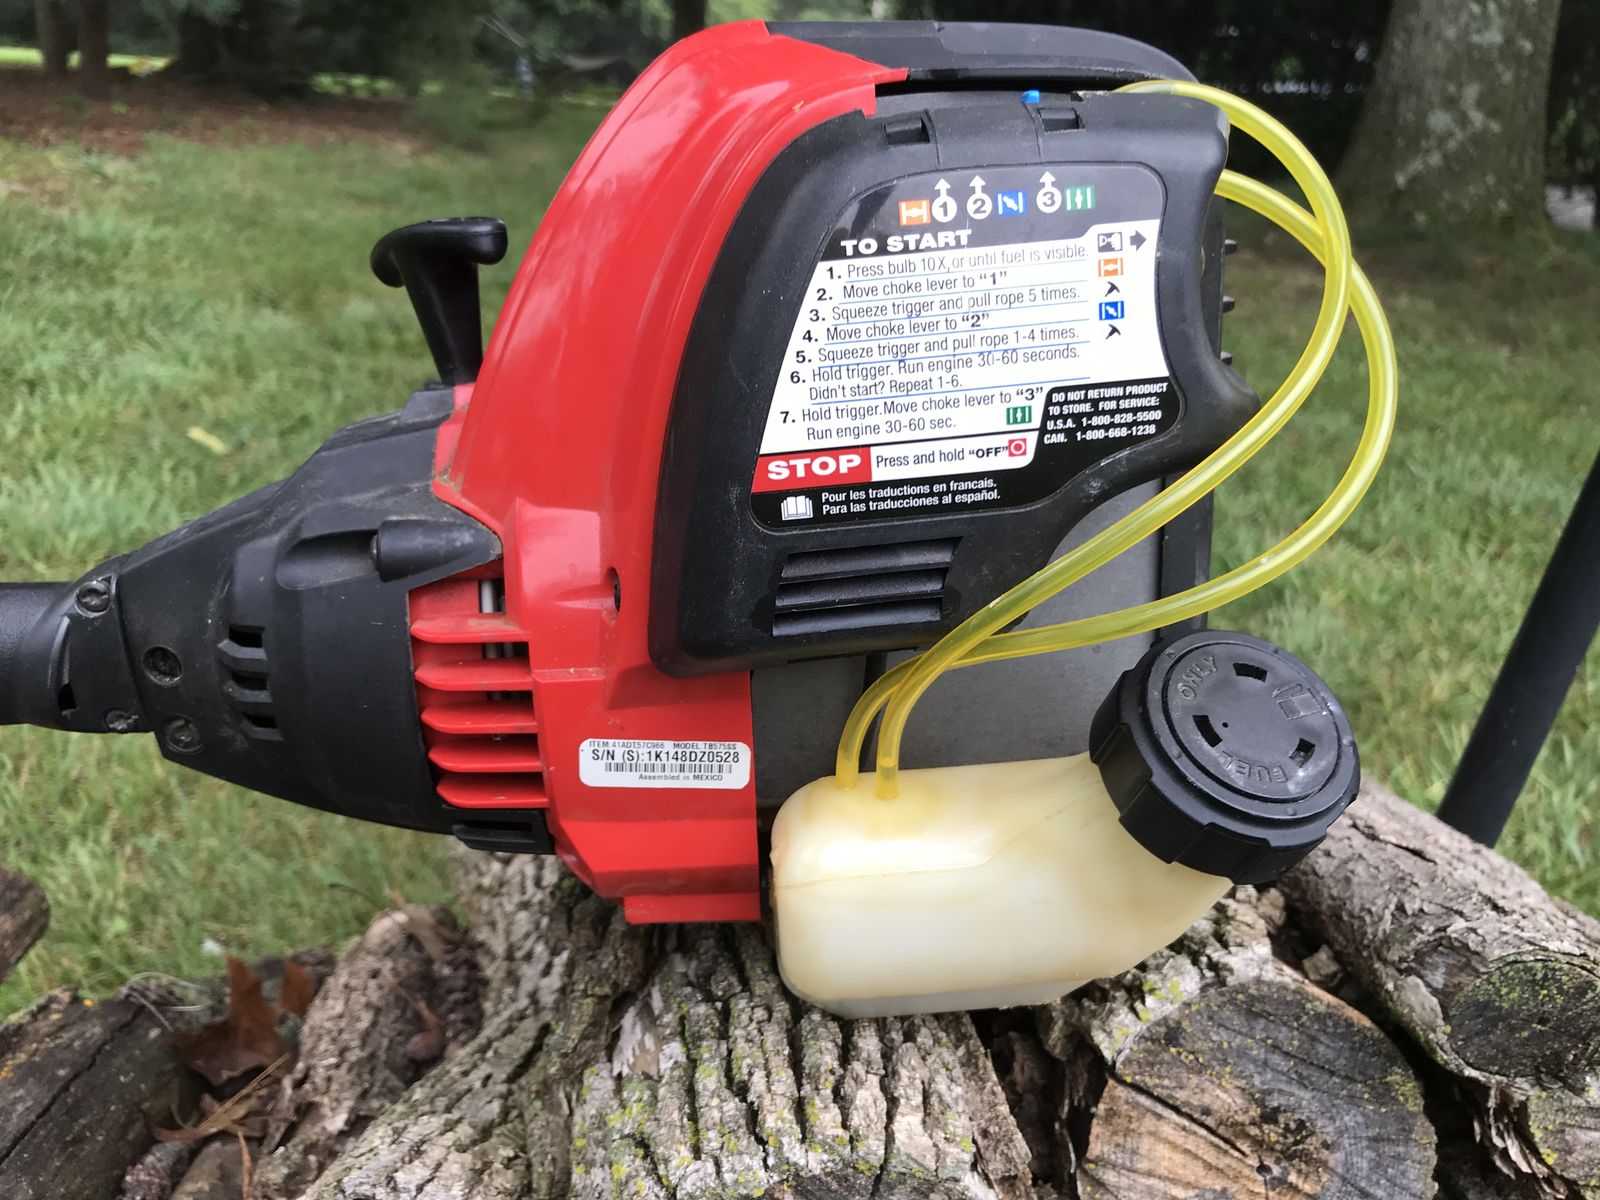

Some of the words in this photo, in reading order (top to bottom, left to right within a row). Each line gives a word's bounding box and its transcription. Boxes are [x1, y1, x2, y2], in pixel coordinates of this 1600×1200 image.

[973, 198, 987, 214] 2
[1042, 191, 1056, 207] 3
[840, 238, 878, 256] TO
[886, 229, 972, 253] START
[826, 266, 841, 280] 1.
[847, 262, 884, 278] Press
[888, 259, 916, 275] bulb
[968, 252, 996, 267] until
[1001, 249, 1025, 263] fuel
[1030, 248, 1040, 261] is
[1045, 244, 1089, 260] visible.
[816, 288, 833, 301] 2.
[843, 284, 878, 299] Move
[882, 279, 922, 296] choke
[926, 276, 957, 291] lever
[962, 275, 975, 288] to
[809, 308, 826, 322] 3.
[832, 305, 888, 324] Squeeze
[892, 300, 934, 318] trigger
[939, 296, 963, 310] and
[968, 293, 991, 312] pull
[995, 292, 1024, 309] rope
[1028, 288, 1036, 302] 5
[1041, 287, 1080, 301] times.
[802, 330, 818, 343] 4.
[826, 327, 862, 341] Move
[865, 321, 905, 338] choke
[909, 320, 941, 335] lever
[945, 317, 957, 331] to
[795, 350, 812, 364] 5.
[818, 346, 873, 364] Squeeze
[878, 342, 920, 358] trigger
[924, 337, 948, 352] and
[953, 334, 975, 353] pull
[980, 333, 1009, 348] rope
[1014, 329, 1036, 344] 1-4
[1040, 327, 1079, 342] times.
[790, 370, 806, 384] 6.
[812, 365, 842, 382] Hold
[846, 363, 894, 381] trigger.
[898, 359, 924, 375] Run
[927, 355, 973, 374] engine
[977, 350, 1018, 367] 30-60
[1022, 345, 1080, 363] seconds.
[850, 381, 885, 397] start?
[889, 377, 933, 396] Repeat
[938, 374, 963, 389] 1-6.
[1052, 392, 1066, 403] DO
[1067, 390, 1086, 401] NOT
[1087, 387, 1124, 400] RETURN
[1125, 382, 1168, 396] PRODUCT
[780, 411, 796, 424] 7.
[802, 407, 831, 422] Hold
[922, 394, 960, 411] choke
[964, 391, 996, 407] lever
[1000, 390, 1012, 404] to
[1048, 406, 1061, 416] TO
[1062, 402, 1094, 414] STORE.
[1098, 400, 1117, 411] FOR
[1119, 396, 1160, 409] SERVICE:
[807, 427, 833, 441] Run
[836, 423, 880, 440] engine
[885, 417, 926, 434] 30-60
[930, 417, 956, 430] sec.
[1046, 418, 1076, 430] U.S.A.
[1081, 410, 1162, 427] 1-800-828-5500
[1043, 432, 1068, 444] CAN.
[1075, 424, 1156, 441] 1-800-668-1238
[767, 454, 861, 480] STOP
[876, 455, 909, 468] Press
[913, 450, 935, 465] and
[939, 448, 965, 462] hold
[821, 491, 847, 503] Pour
[849, 489, 866, 500] les
[868, 483, 930, 499] traductions
[933, 483, 947, 493] en
[949, 477, 997, 491] francais.
[822, 504, 848, 515] Para
[850, 502, 866, 513] las
[869, 493, 939, 511] traducciones
[941, 494, 952, 504] al
[954, 488, 1001, 504] español.
[1180, 655, 1217, 701] ONLY
[591, 749, 615, 761] S/N
[1220, 750, 1288, 784] FUEL
[638, 773, 680, 781] Assembled
[683, 773, 690, 781] in
[692, 774, 723, 782] MEXICO
